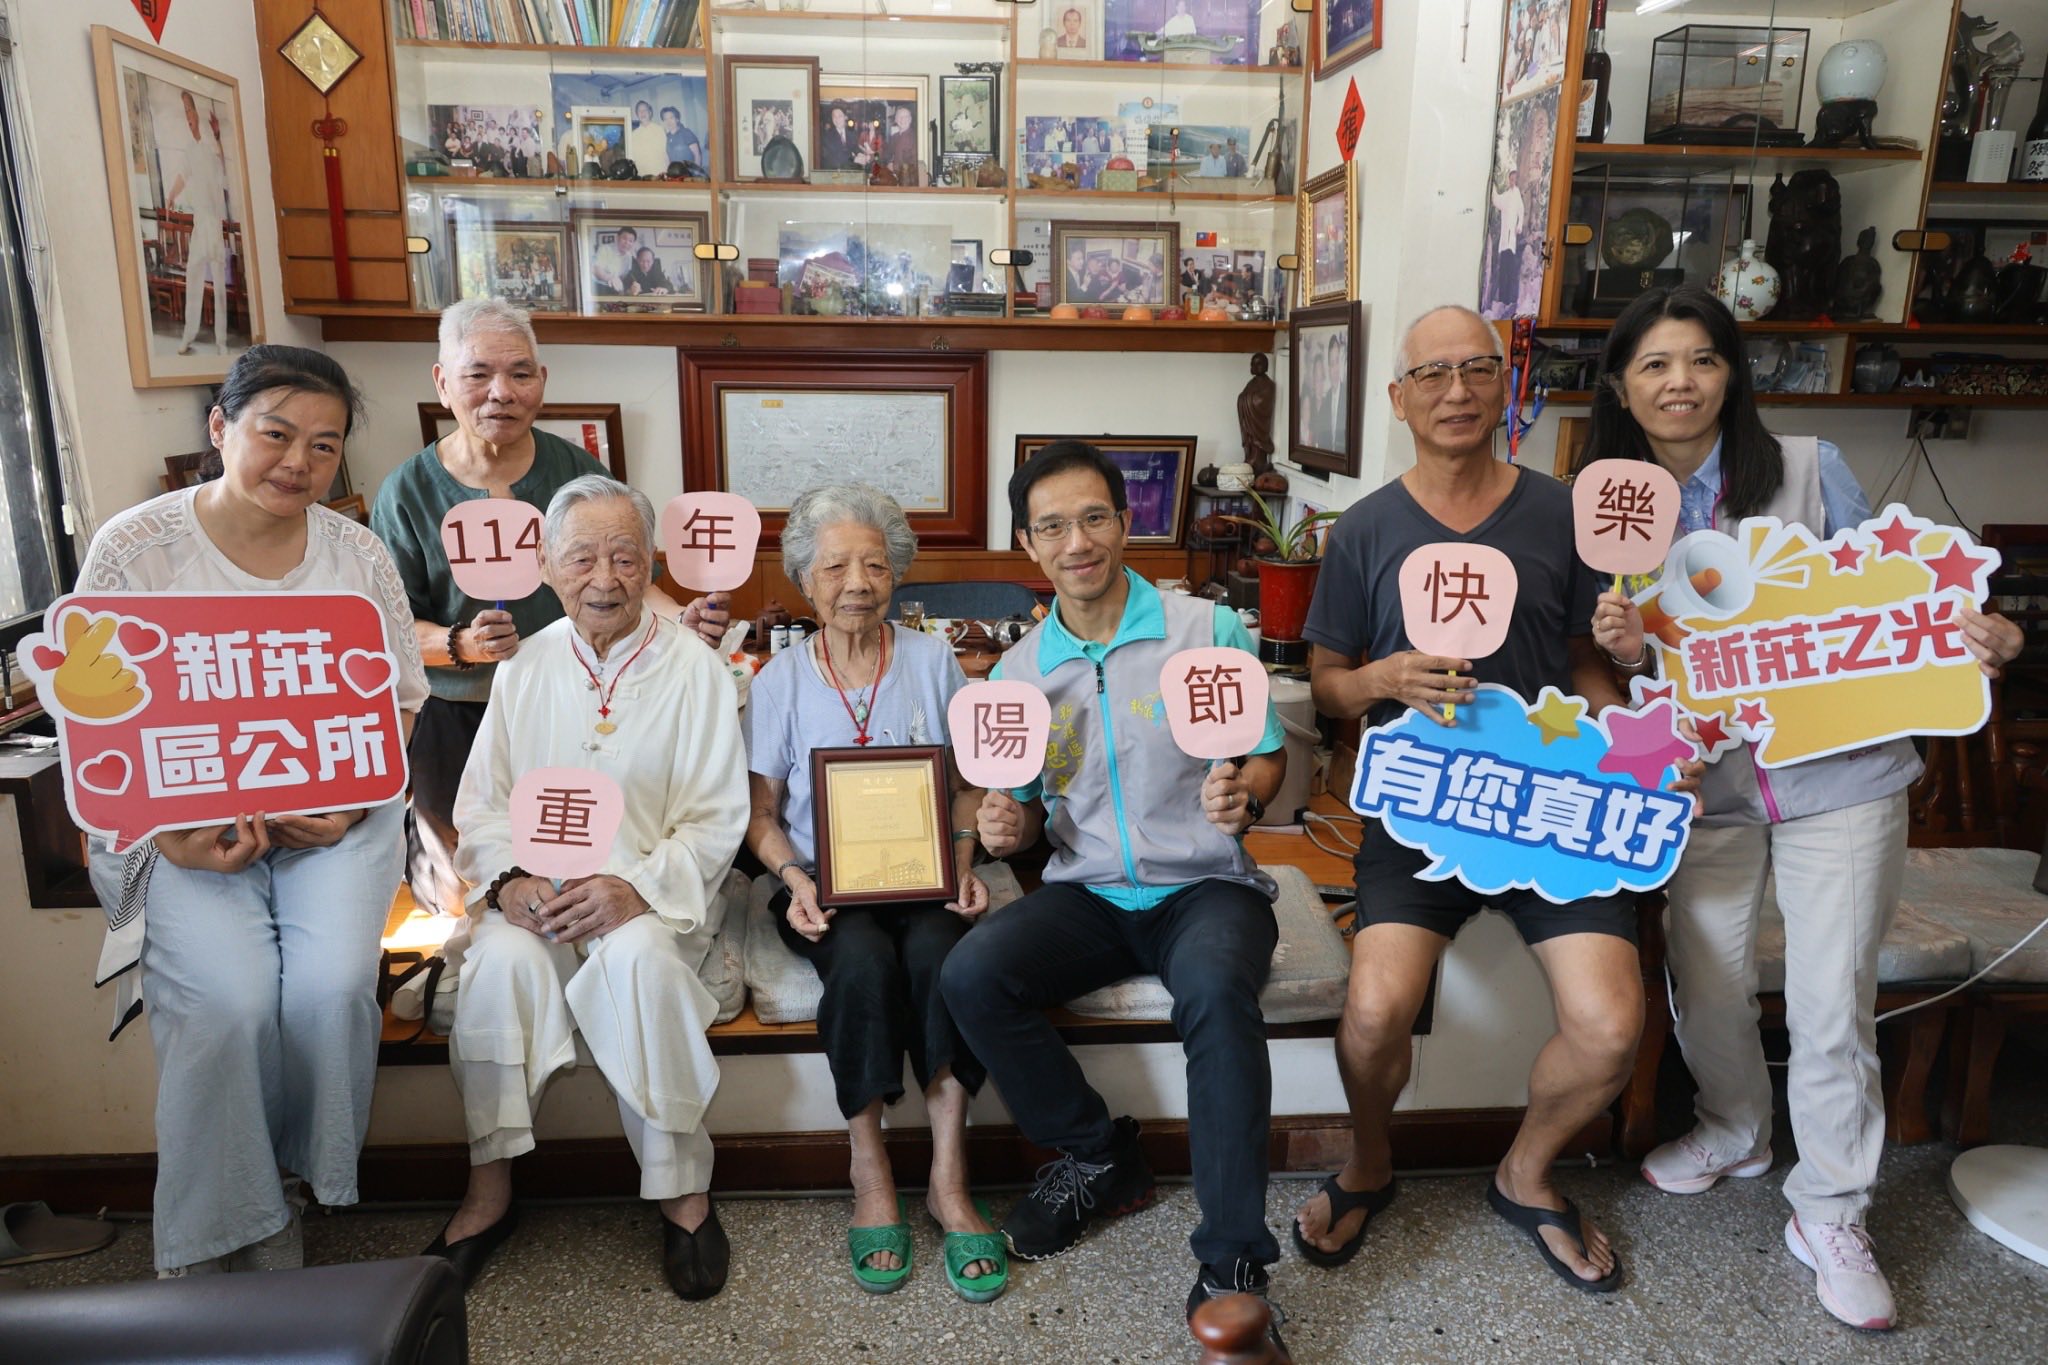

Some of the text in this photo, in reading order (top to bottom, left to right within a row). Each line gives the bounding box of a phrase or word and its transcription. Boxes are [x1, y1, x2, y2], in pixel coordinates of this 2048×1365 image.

[1342, 102, 1358, 152] 福
[448, 517, 540, 565] 114
[681, 508, 736, 563] 年
[1593, 478, 1655, 542] 樂
[1423, 560, 1490, 625] 快
[173, 629, 338, 701] 新莊
[1688, 600, 1966, 692] 新莊之光
[1183, 664, 1244, 724] 節
[139, 712, 388, 798] 區公所
[974, 703, 1029, 759] 陽
[530, 788, 597, 846] 重
[1361, 739, 1685, 868] 有您真好
